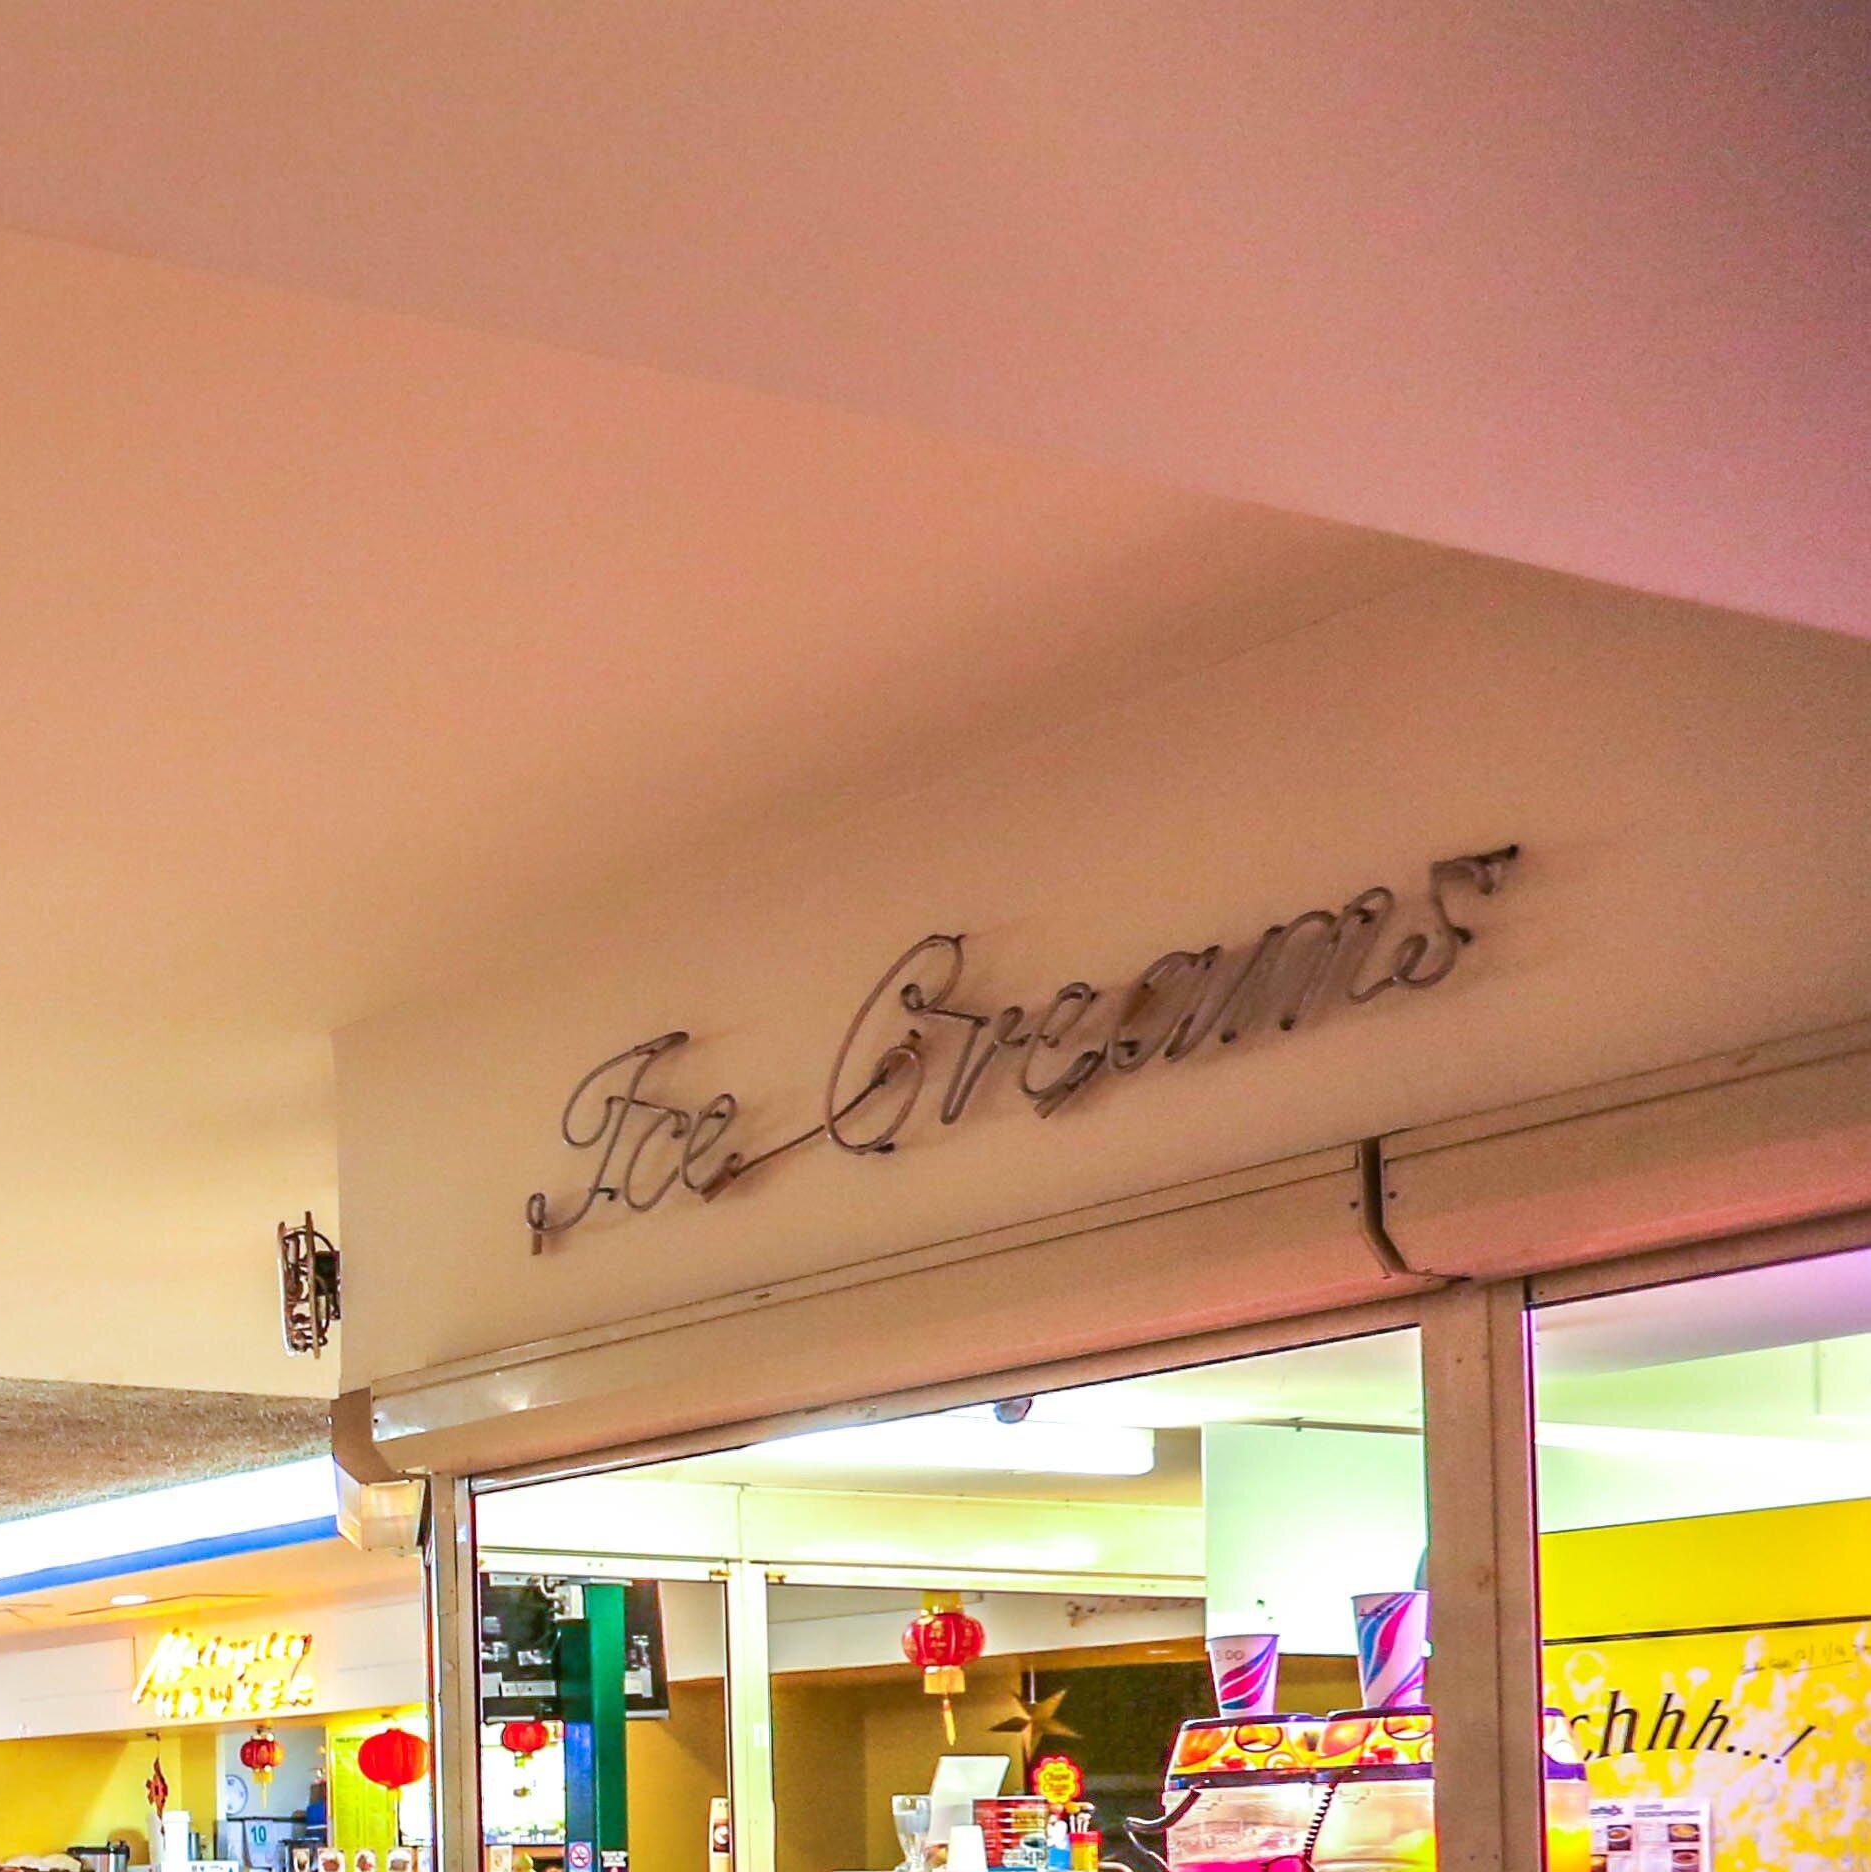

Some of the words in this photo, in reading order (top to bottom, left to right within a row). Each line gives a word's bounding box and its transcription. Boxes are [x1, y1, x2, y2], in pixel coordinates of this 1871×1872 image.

[525, 1030, 743, 1257] Ice
[823, 844, 1521, 1156] Creams
[250, 1825, 267, 1843] 10
